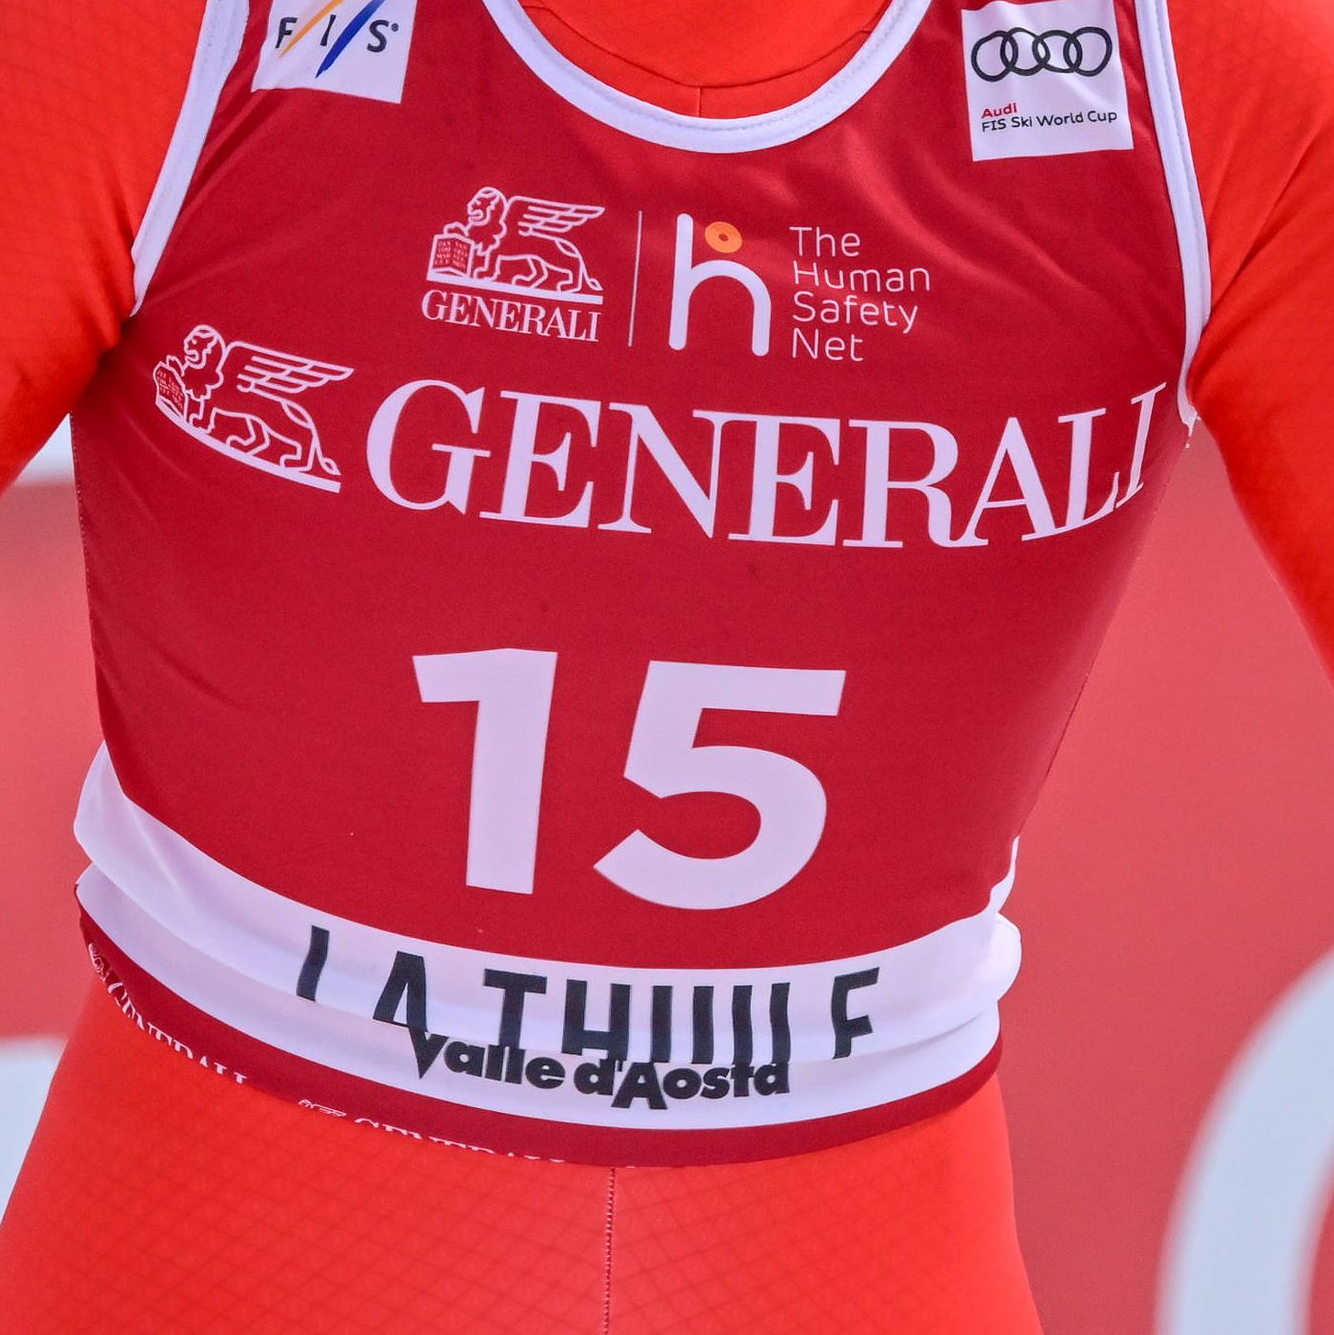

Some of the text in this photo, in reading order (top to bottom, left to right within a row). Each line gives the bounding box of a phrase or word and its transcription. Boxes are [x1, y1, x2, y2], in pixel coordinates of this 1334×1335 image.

[981, 102, 1018, 119] Audi
[982, 110, 1118, 133] FIS Ski World Cup
[789, 226, 862, 258] The
[792, 260, 931, 293] Human
[420, 288, 601, 343] GENERALI
[791, 291, 919, 334] Safety
[791, 327, 865, 362] Net
[367, 379, 1167, 550] GENERALI
[411, 647, 846, 911] 15
[407, 1028, 567, 1090] Valle
